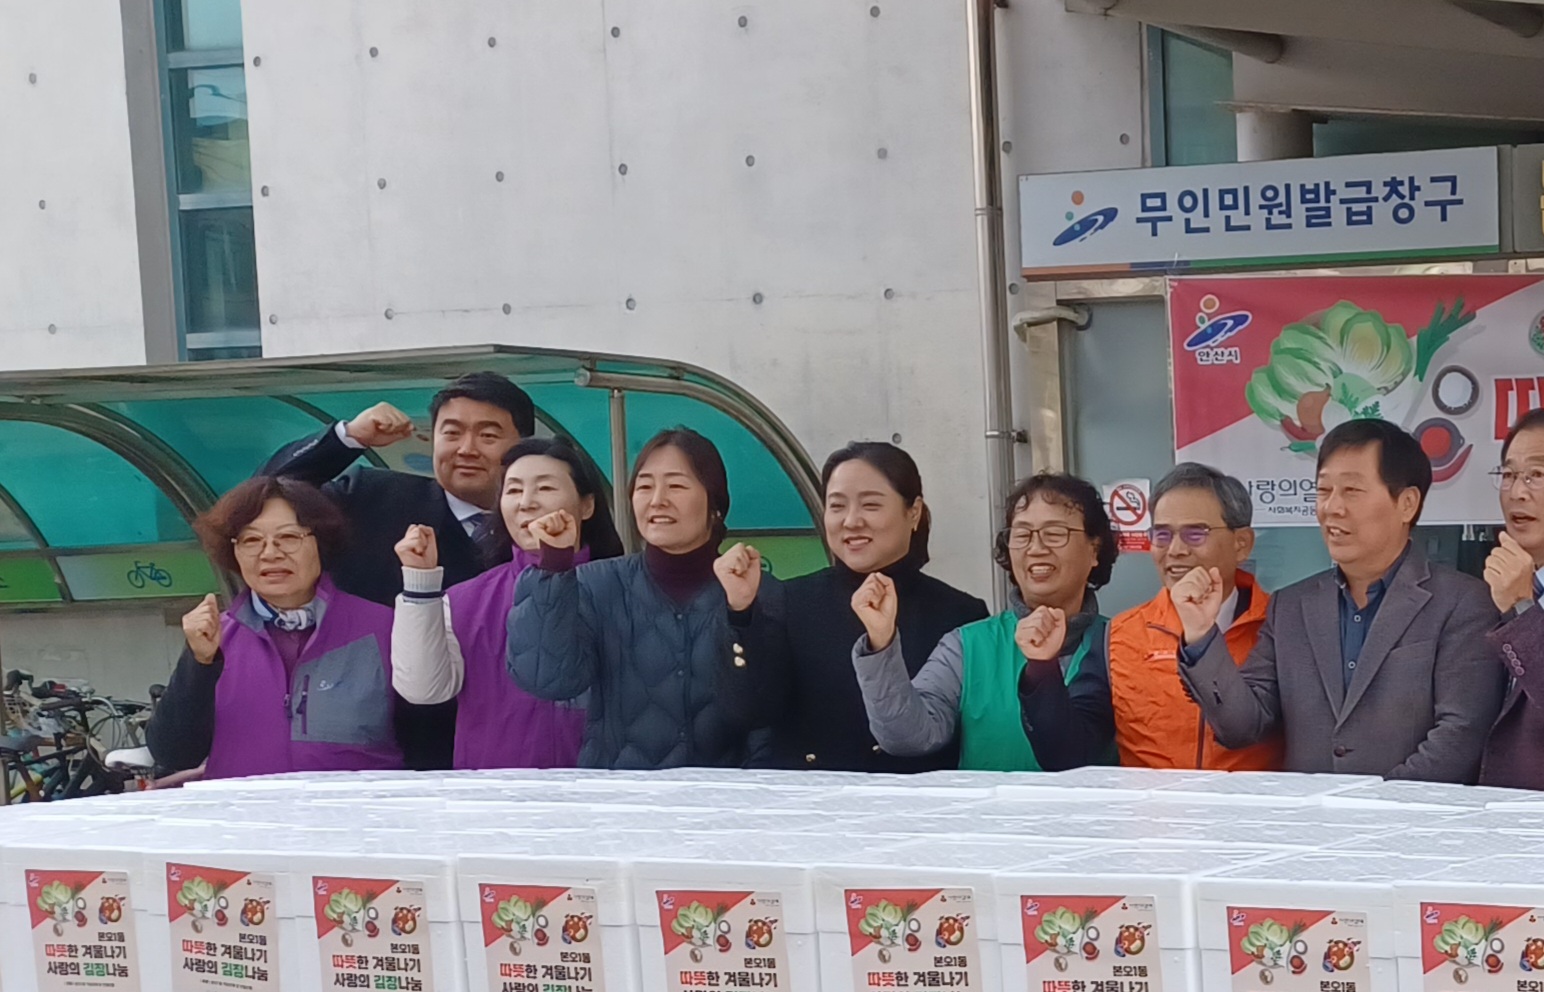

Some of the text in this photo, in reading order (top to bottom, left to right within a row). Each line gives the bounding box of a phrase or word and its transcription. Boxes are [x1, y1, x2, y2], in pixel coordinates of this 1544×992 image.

[1135, 174, 1465, 237] 무인민원발급창구
[1196, 349, 1239, 363] 안산시
[181, 938, 267, 963] 따뜻한 겨울나기
[182, 957, 269, 981] 사랑의 김장나눔
[499, 963, 592, 982] 따뜻한 겨울나기
[866, 969, 969, 988] 따뜻한 겨울나기
